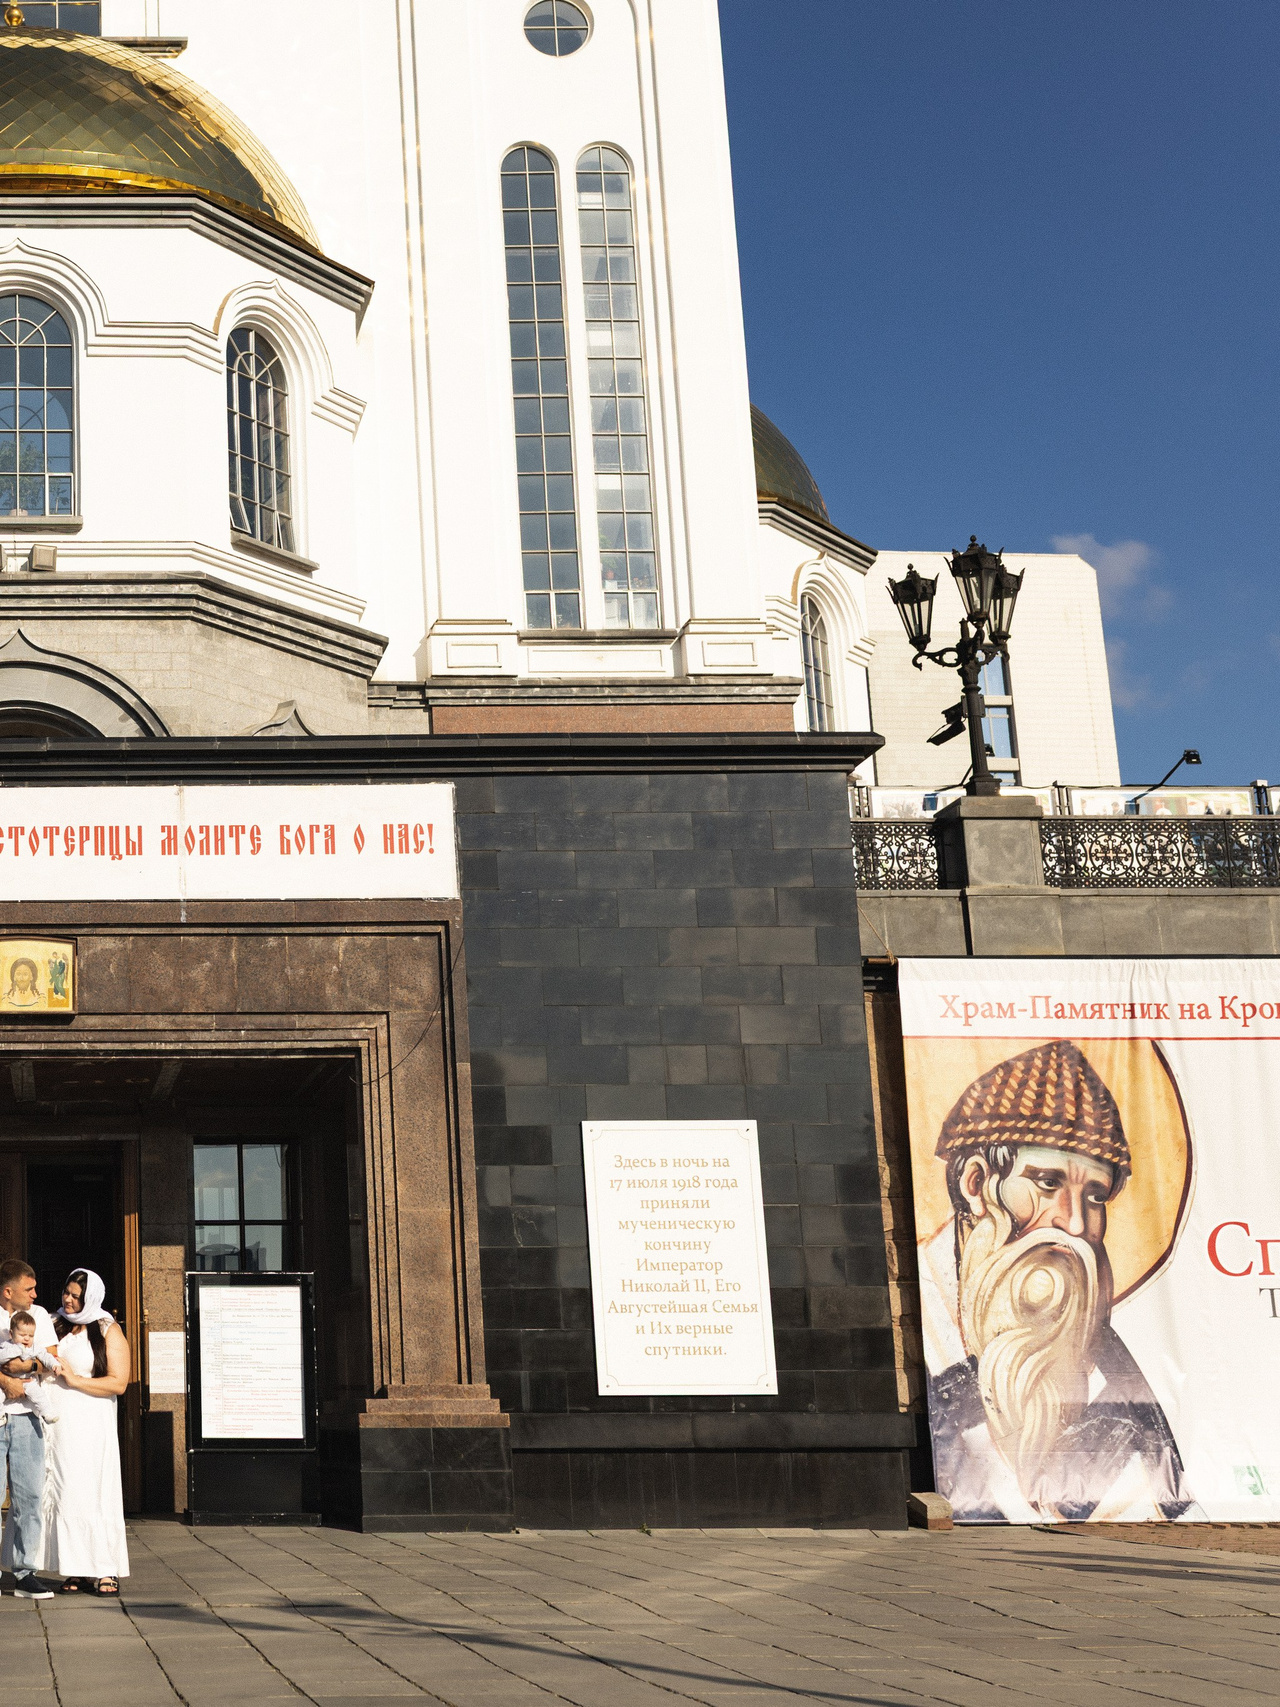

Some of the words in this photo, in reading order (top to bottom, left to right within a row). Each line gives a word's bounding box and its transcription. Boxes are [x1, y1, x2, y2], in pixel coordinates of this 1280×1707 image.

[160, 824, 262, 856] МОЛИТЕ
[279, 824, 336, 855] БОГА
[353, 823, 365, 855] О
[382, 823, 435, 855] НАС!
[938, 994, 1171, 1027] Храм-Памятник
[1177, 1002, 1213, 1020] на
[613, 1154, 657, 1170] Здесь
[659, 1157, 669, 1169] в
[672, 1157, 709, 1169] ночь
[711, 1157, 731, 1169] на
[609, 1178, 623, 1192] 17
[626, 1178, 668, 1190] июля
[672, 1176, 702, 1191] 1918
[704, 1177, 739, 1191] года
[640, 1199, 711, 1213] приняли
[618, 1219, 736, 1234] мученическую
[644, 1240, 712, 1255] кончину
[636, 1258, 724, 1275] Император
[621, 1278, 691, 1293] Николай
[715, 1278, 742, 1293] Его
[607, 1299, 708, 1317] Августейшая
[711, 1299, 759, 1314] Семья
[635, 1324, 646, 1335] и
[650, 1320, 672, 1335] Их
[676, 1324, 734, 1338] верные
[643, 1344, 727, 1360] спутники.
